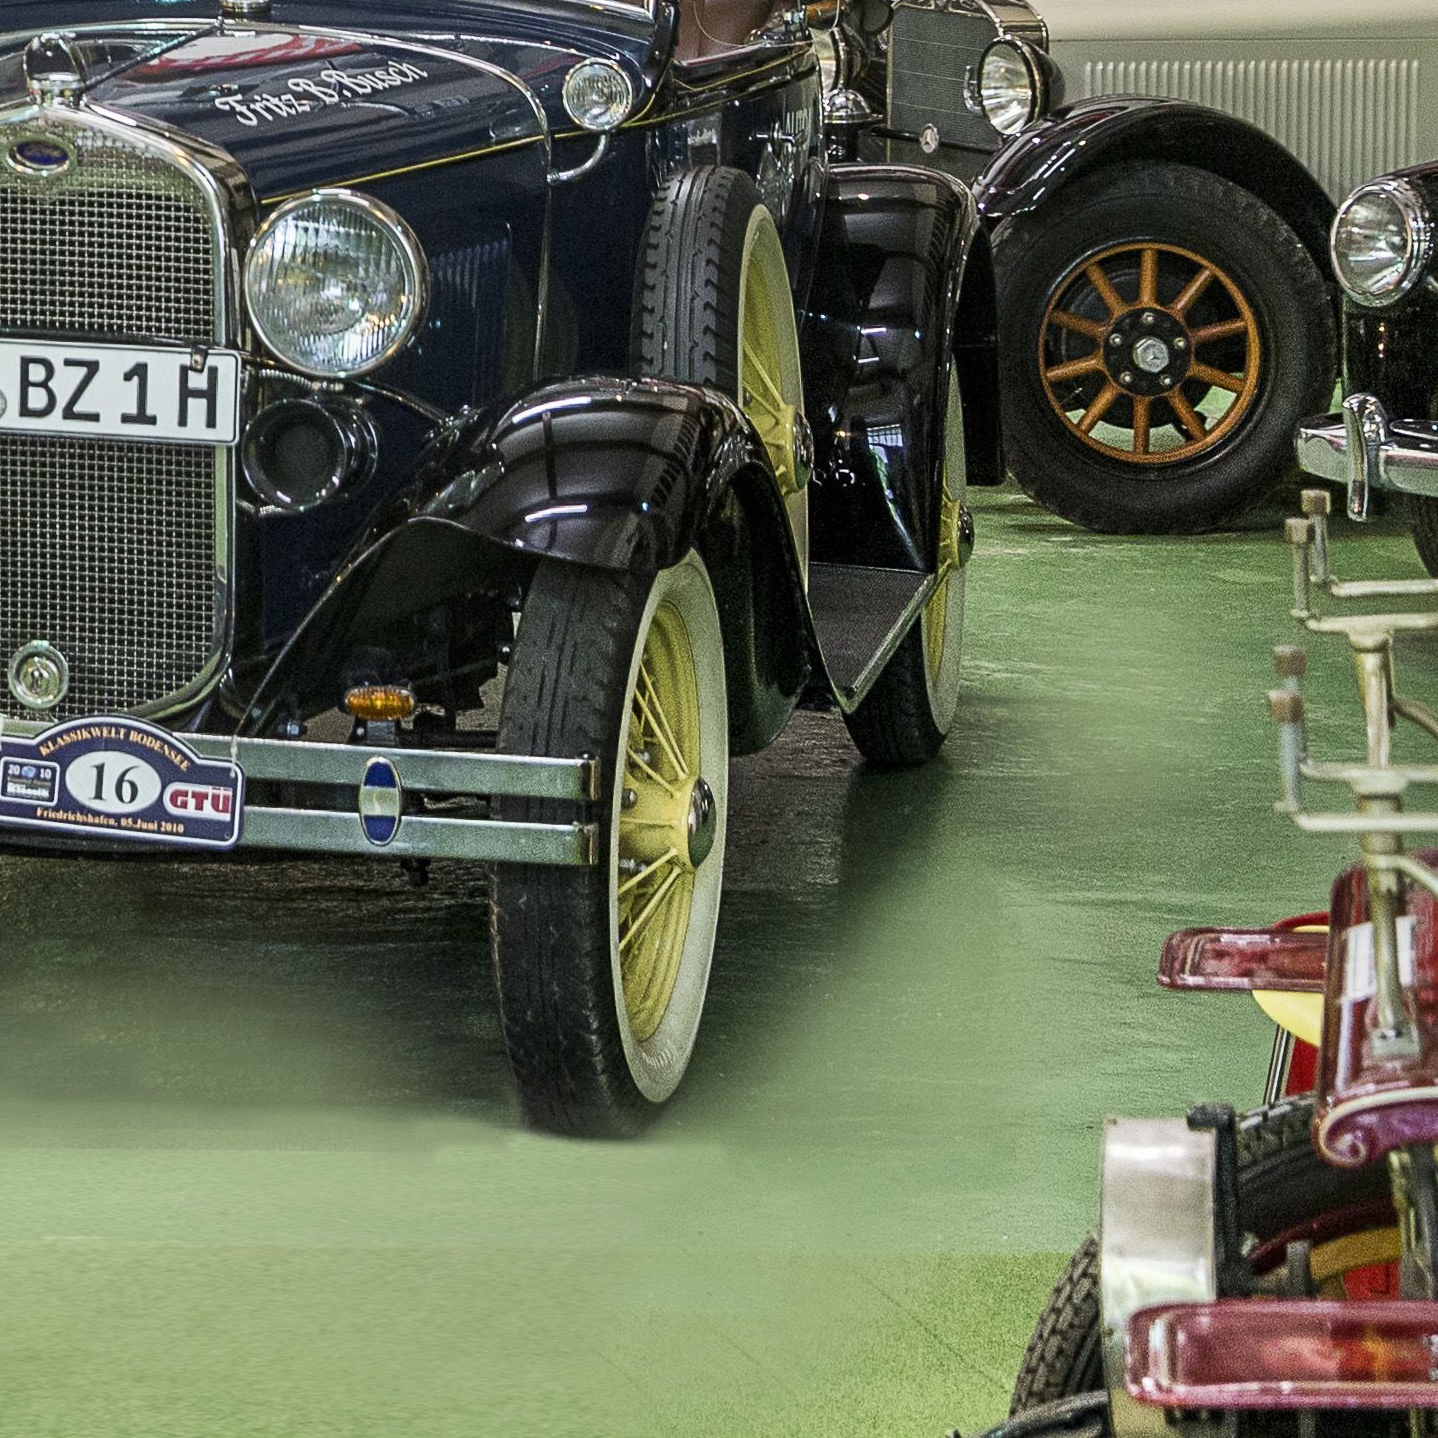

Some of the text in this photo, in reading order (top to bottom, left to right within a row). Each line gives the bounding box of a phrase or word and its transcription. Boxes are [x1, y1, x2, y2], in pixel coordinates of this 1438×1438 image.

[214, 93, 312, 127] Fritz
[319, 60, 429, 95] Busch
[18, 354, 102, 424] BZ
[38, 725, 193, 773] KLASSIKWELT BODENSEE
[89, 761, 141, 805] 16
[169, 786, 233, 814] GTÜ
[159, 820, 185, 834] 2010
